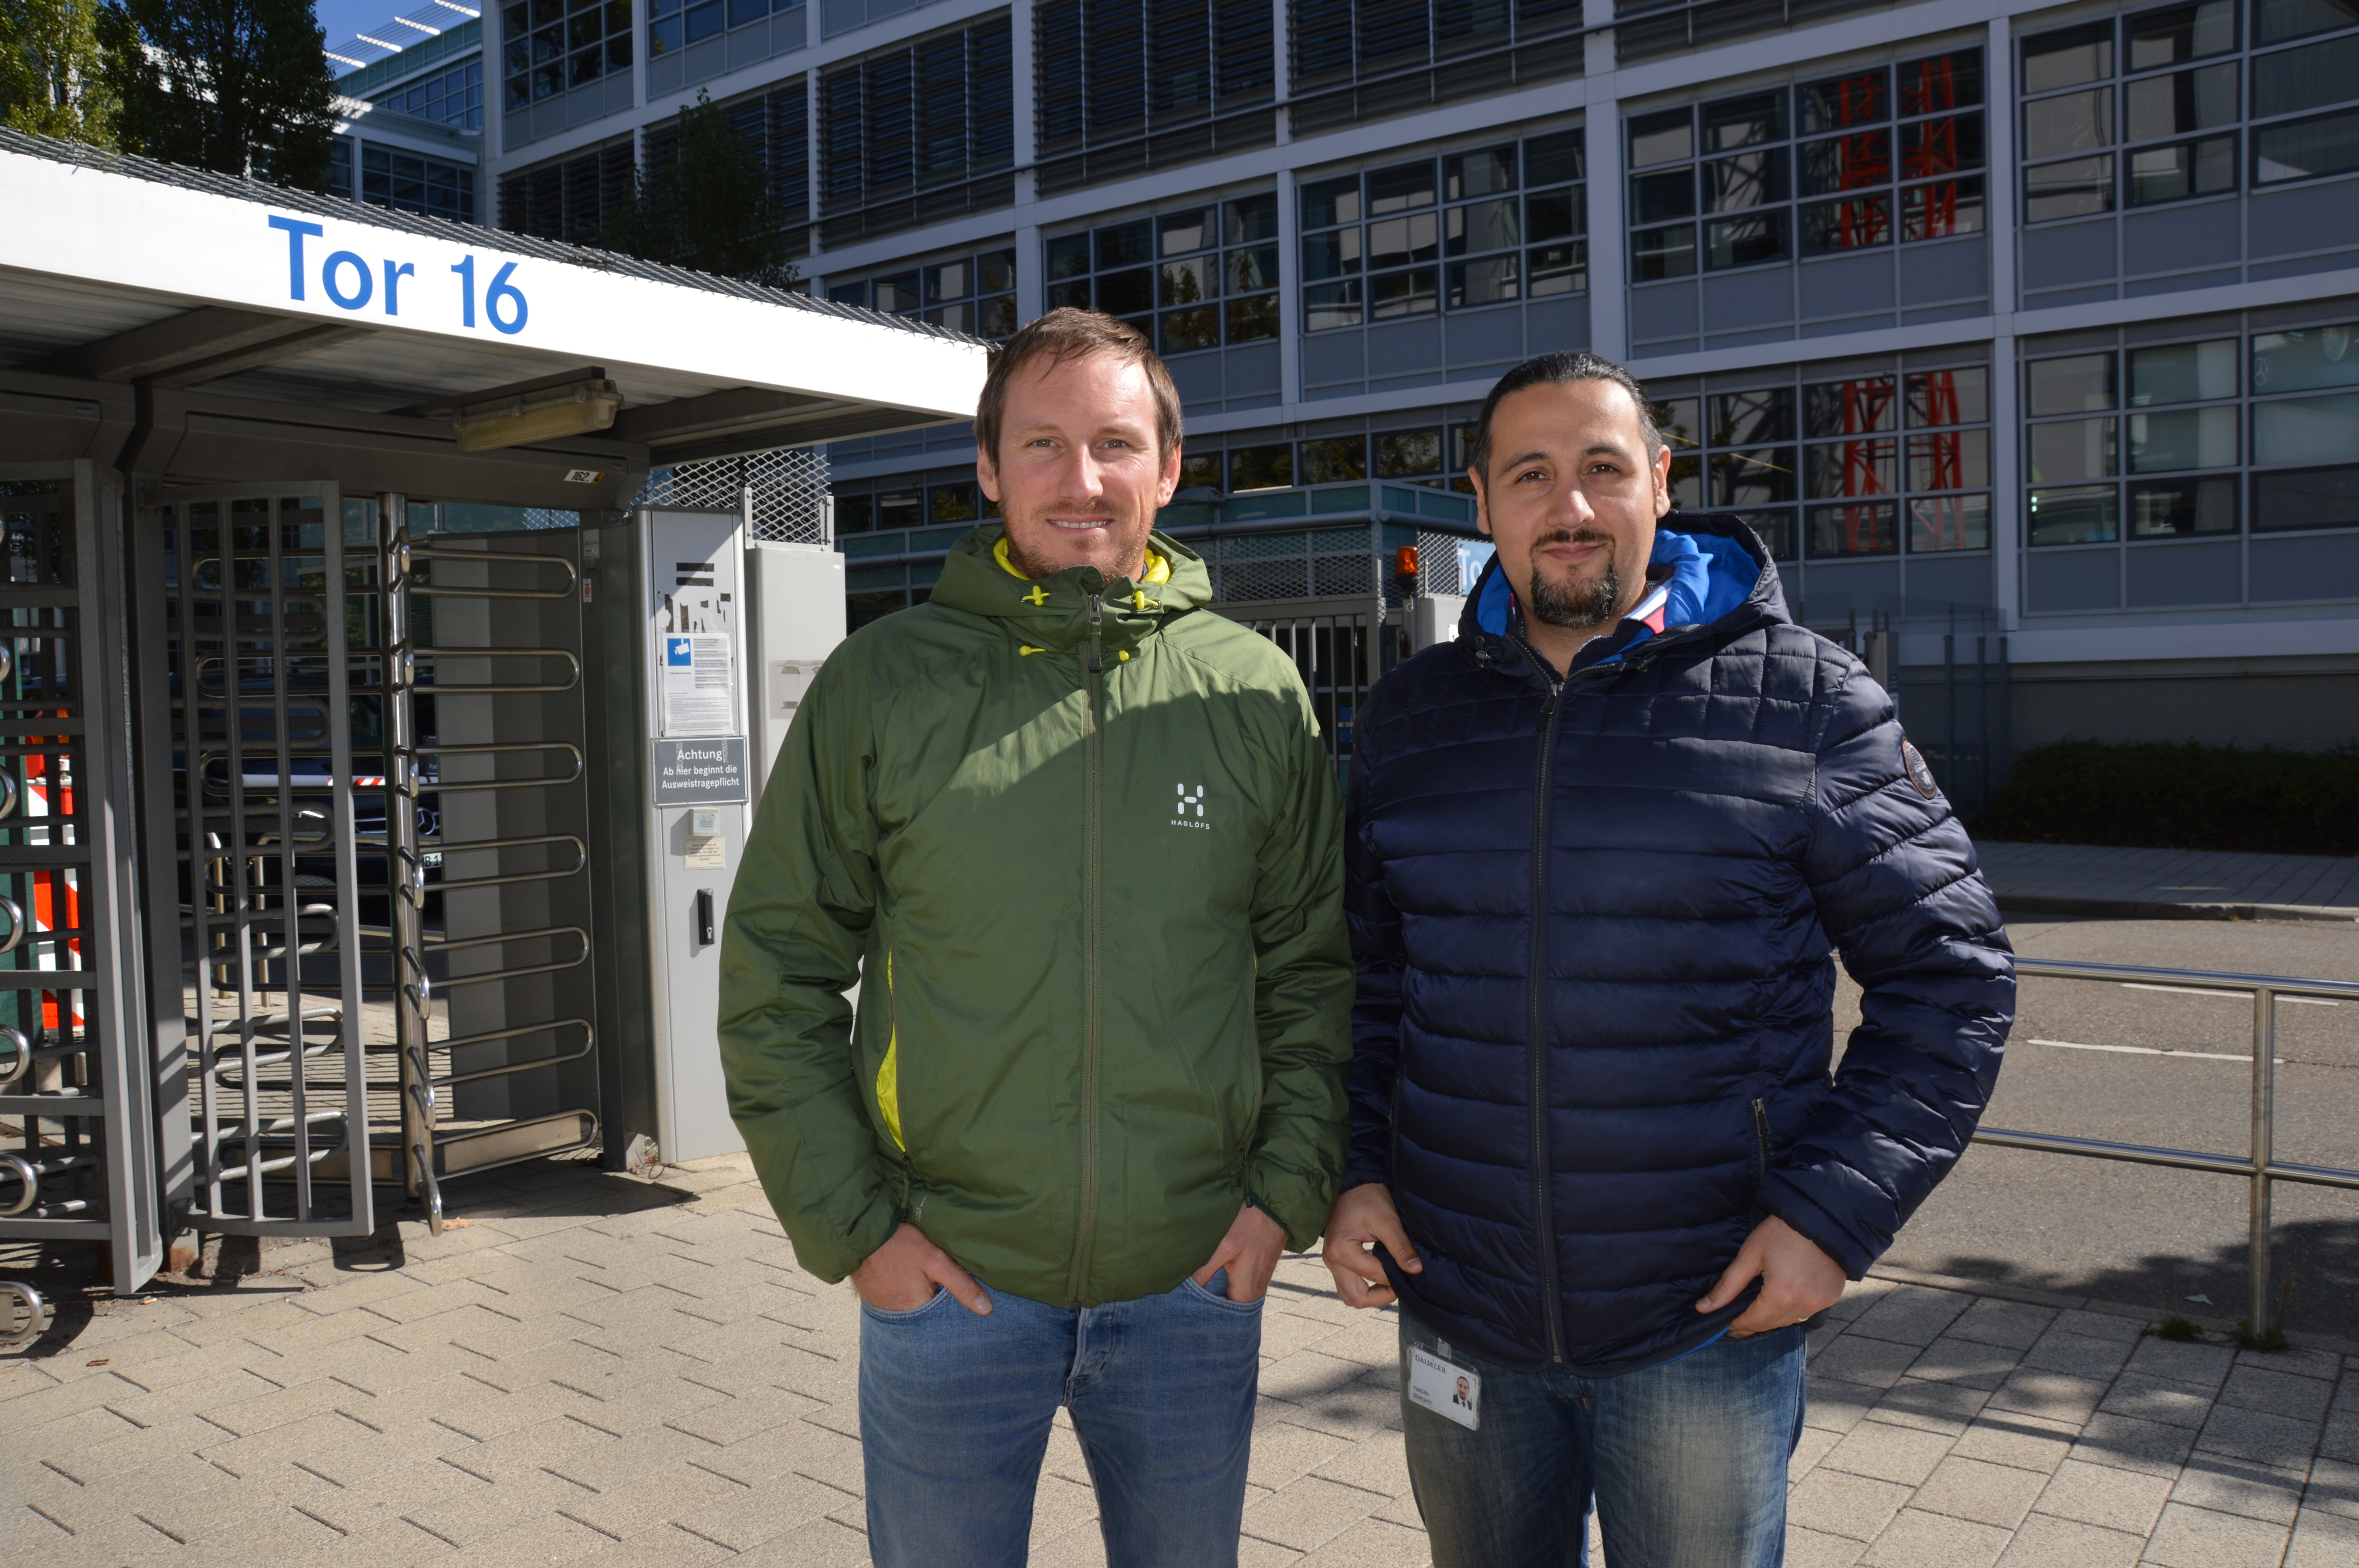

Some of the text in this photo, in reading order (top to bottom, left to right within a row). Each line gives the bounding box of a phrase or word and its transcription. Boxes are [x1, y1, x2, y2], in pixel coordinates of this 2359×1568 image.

[268, 214, 528, 335] Tor 16
[677, 749, 722, 761] Achtung
[663, 765, 737, 776] Ab hier beginnt die
[662, 777, 740, 789] Ausweistragepflicht
[1171, 819, 1210, 829] HAGLÖFS
[1415, 1354, 1447, 1374] DAIMLER
[1413, 1385, 1429, 1397] FARZAD
[1413, 1393, 1432, 1405] SERESHTI
